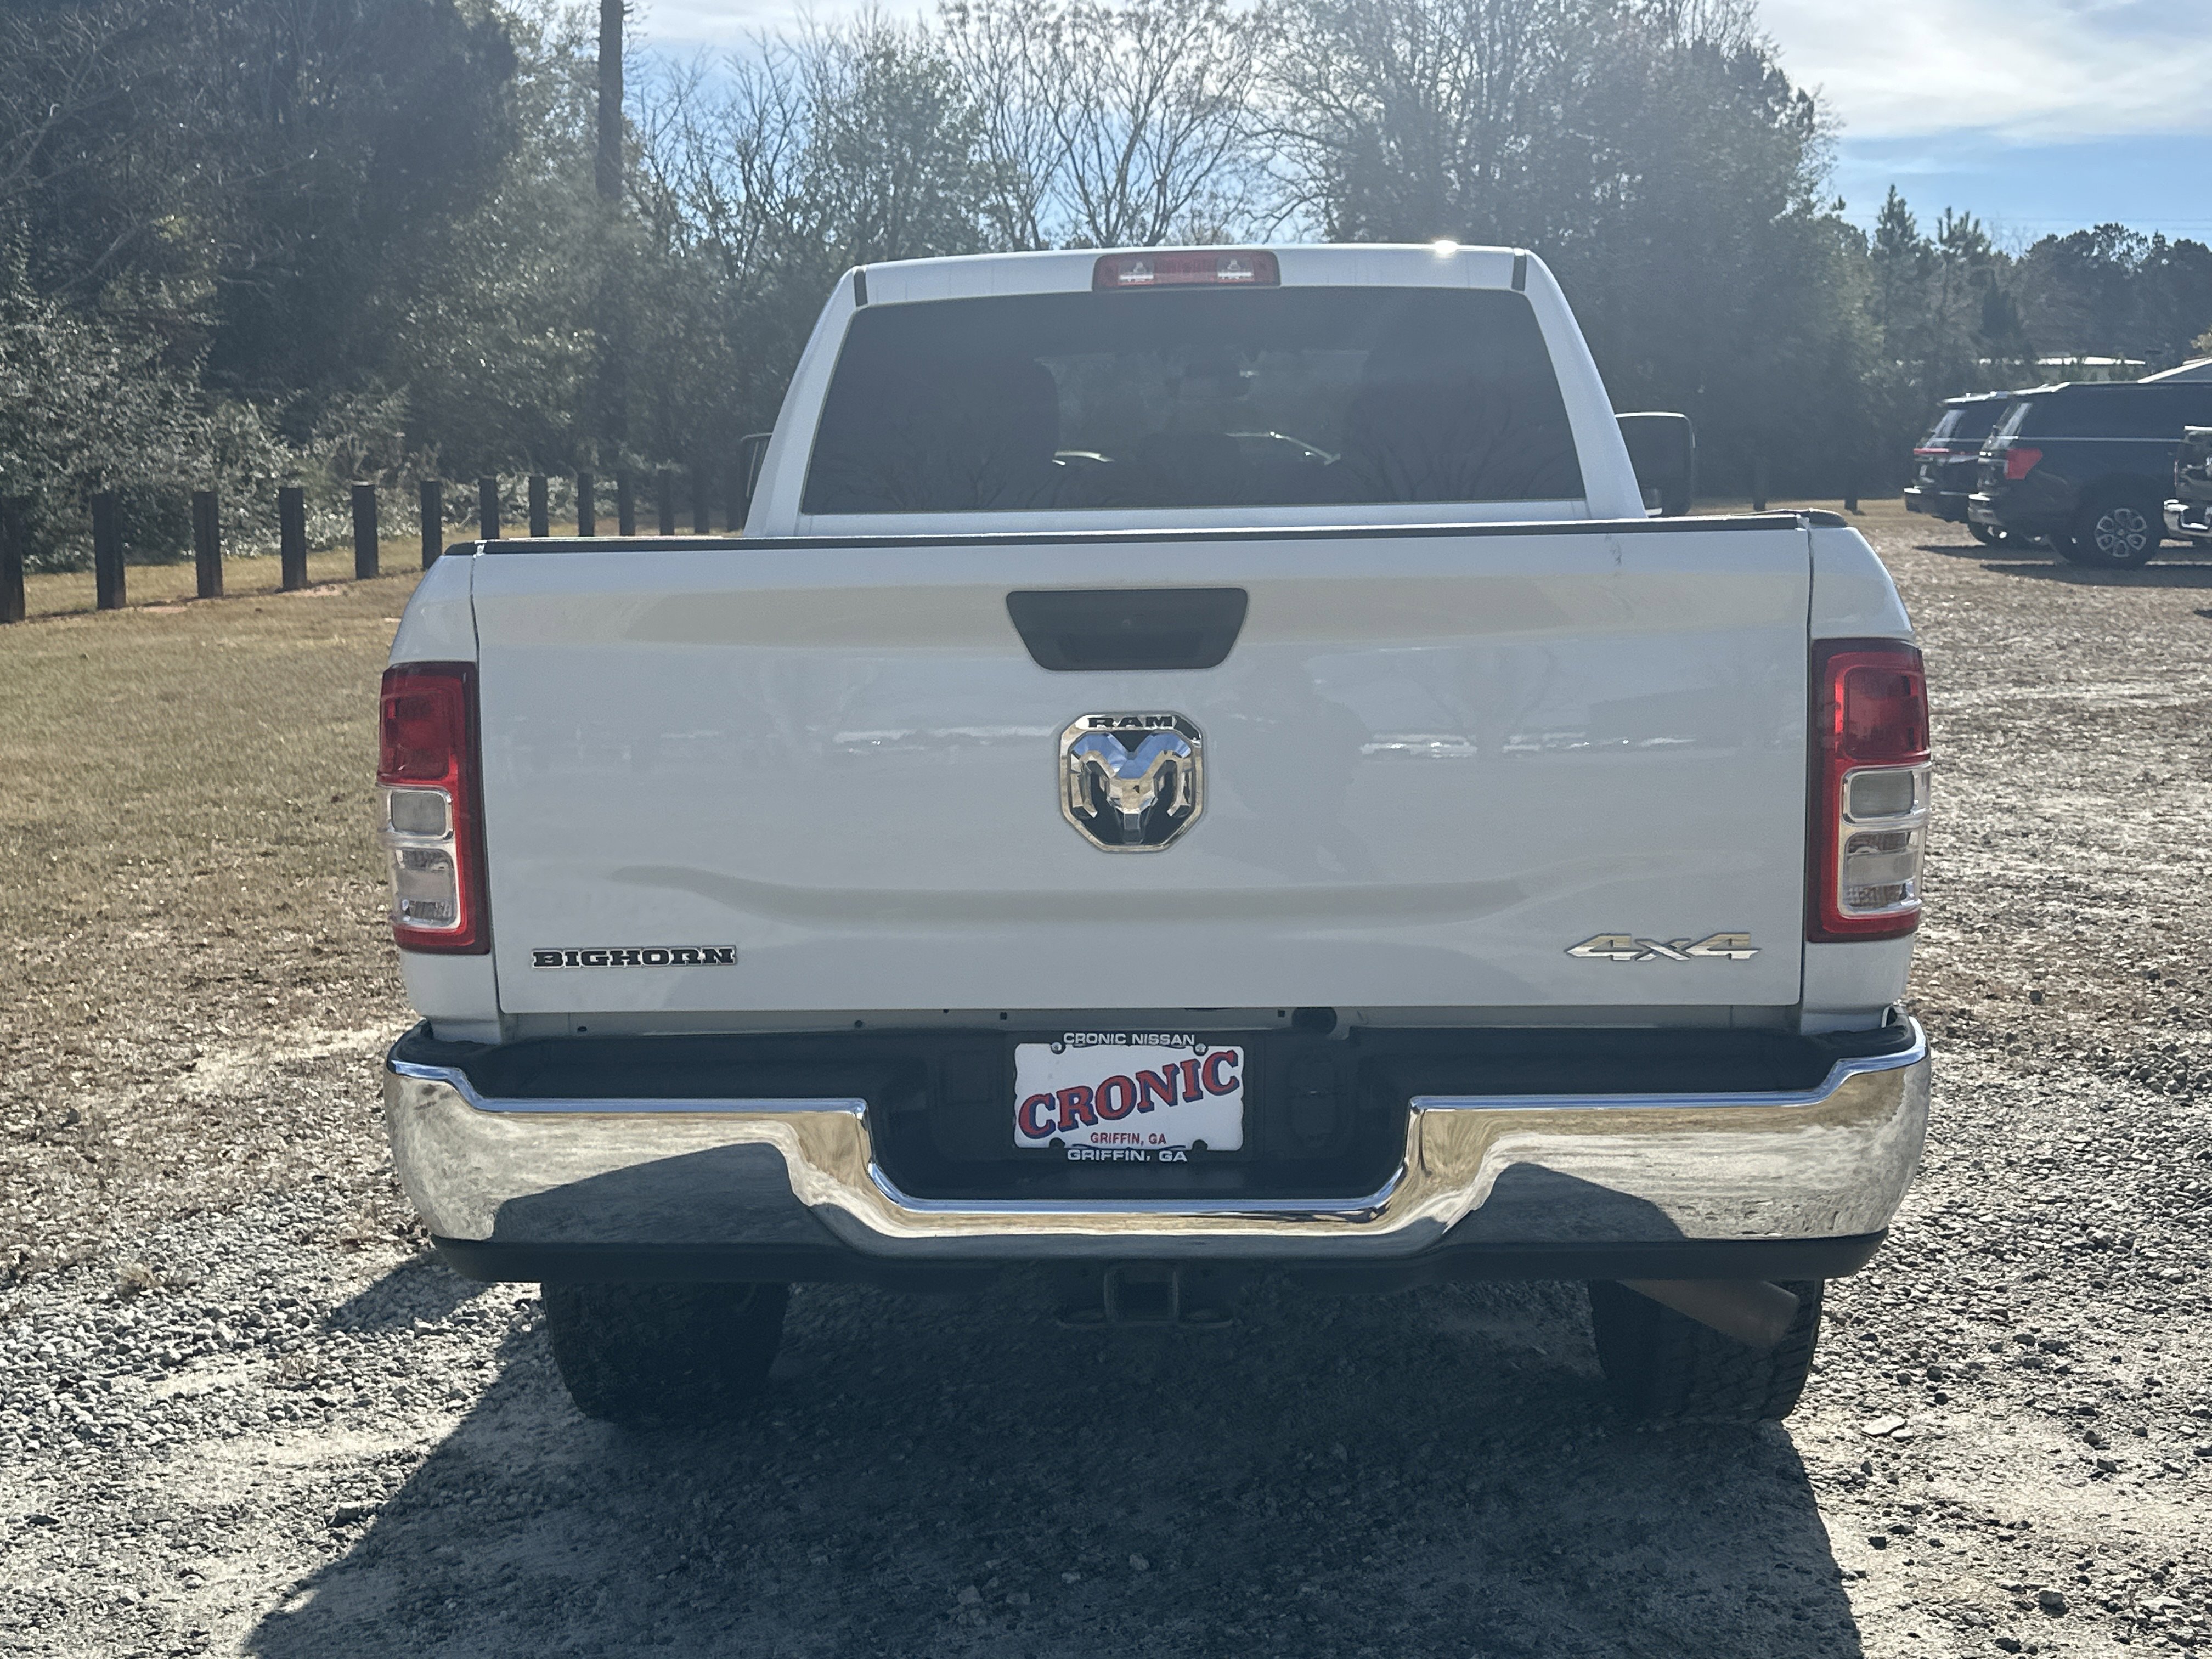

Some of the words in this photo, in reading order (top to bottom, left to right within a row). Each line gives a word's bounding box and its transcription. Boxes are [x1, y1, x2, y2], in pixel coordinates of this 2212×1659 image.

[1087, 716, 1173, 728] RAM
[532, 945, 736, 969] BIGHORN
[1063, 1032, 1126, 1045] CRONIC
[1131, 1033, 1195, 1046] NISSAN
[1018, 1049, 1240, 1139] CRONIC
[1090, 1132, 1144, 1146] GRIFFIN,
[1149, 1133, 1167, 1145] GA
[1066, 1149, 1151, 1162] GRIFFIN,
[1159, 1150, 1188, 1163] GA
